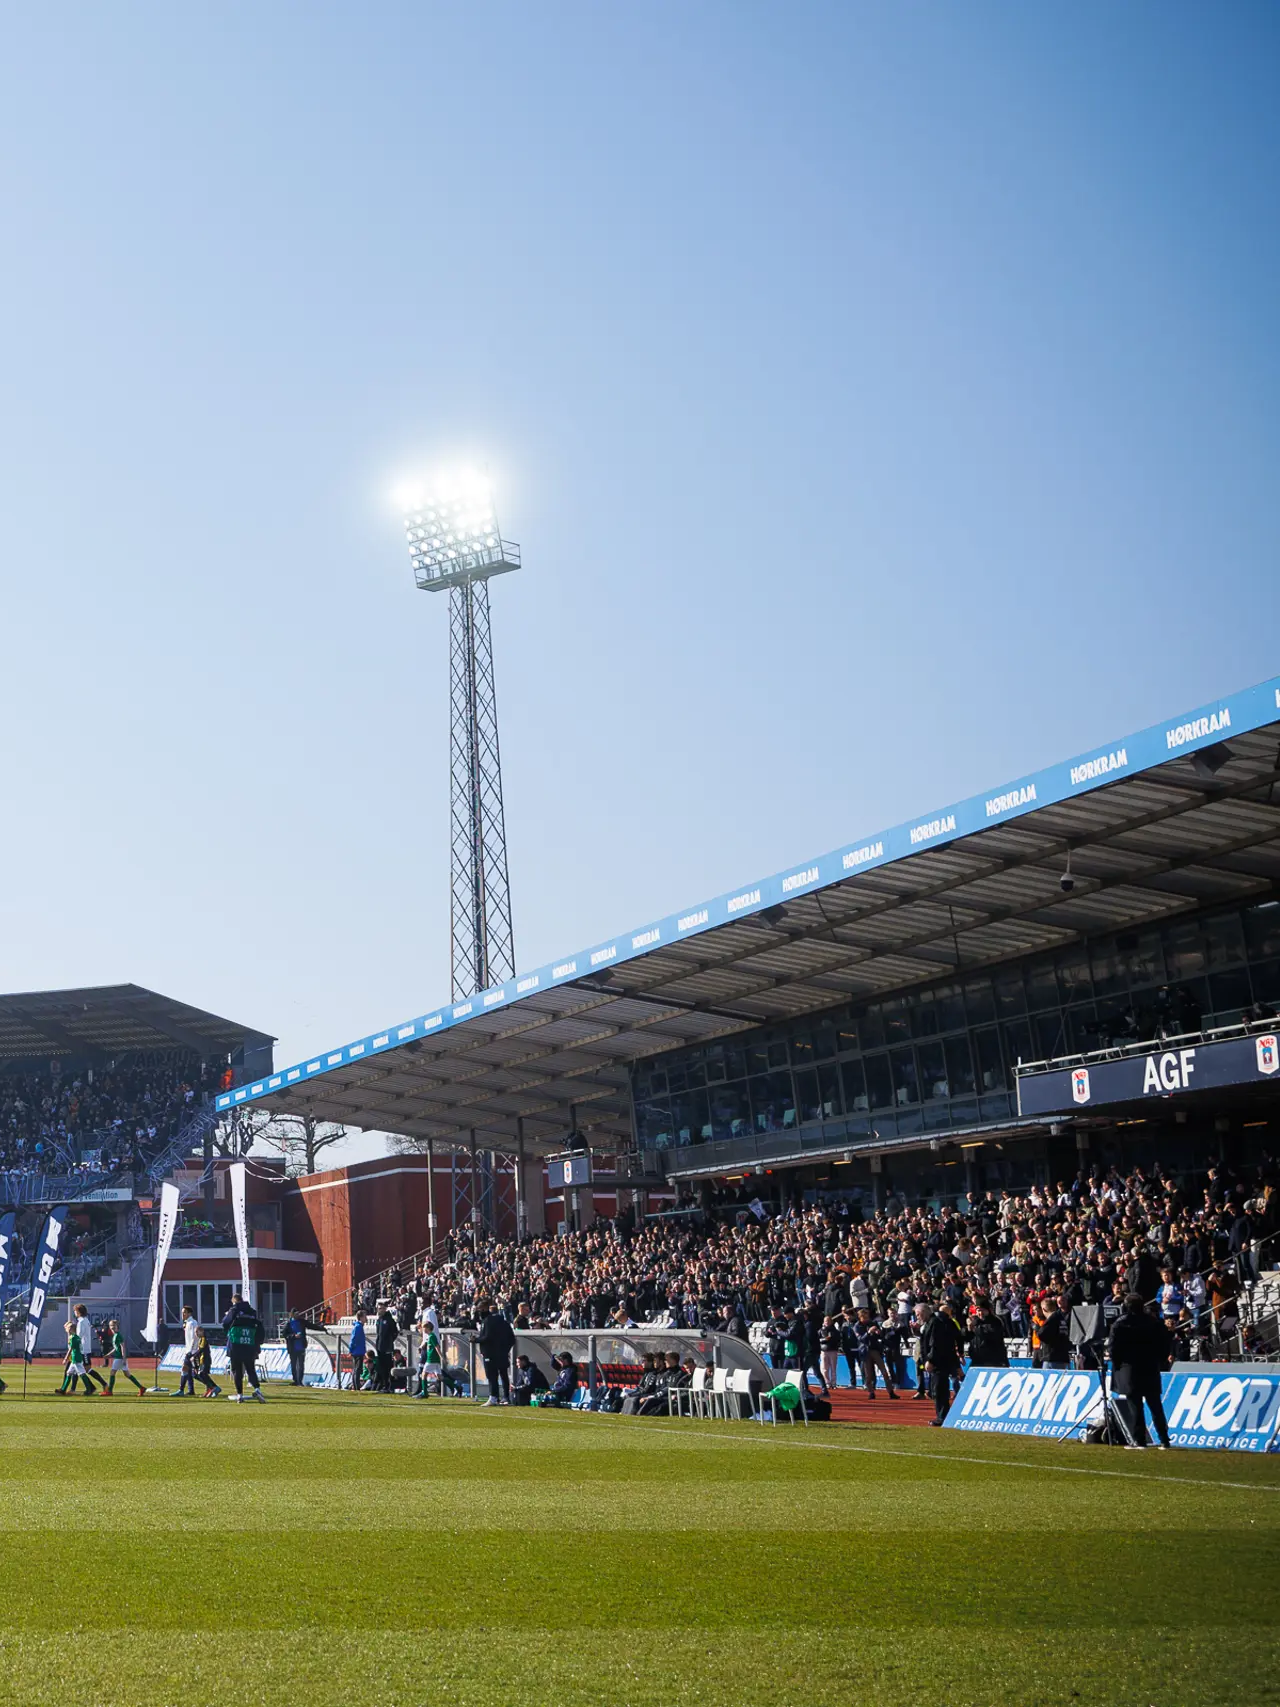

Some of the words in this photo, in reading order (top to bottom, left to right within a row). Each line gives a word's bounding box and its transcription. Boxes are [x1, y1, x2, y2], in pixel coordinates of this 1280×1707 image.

[910, 815, 956, 844] HØRKRAM
[985, 783, 1037, 817] HØRKRAM
[1070, 748, 1128, 785] HØRKRAM
[1166, 708, 1231, 749] HØRKRAM
[1143, 1048, 1196, 1094] AGF
[960, 1371, 1113, 1423] HØRKRA
[954, 1419, 1029, 1433] FOODSERVICE
[1169, 1433, 1259, 1449] OODSERVICE
